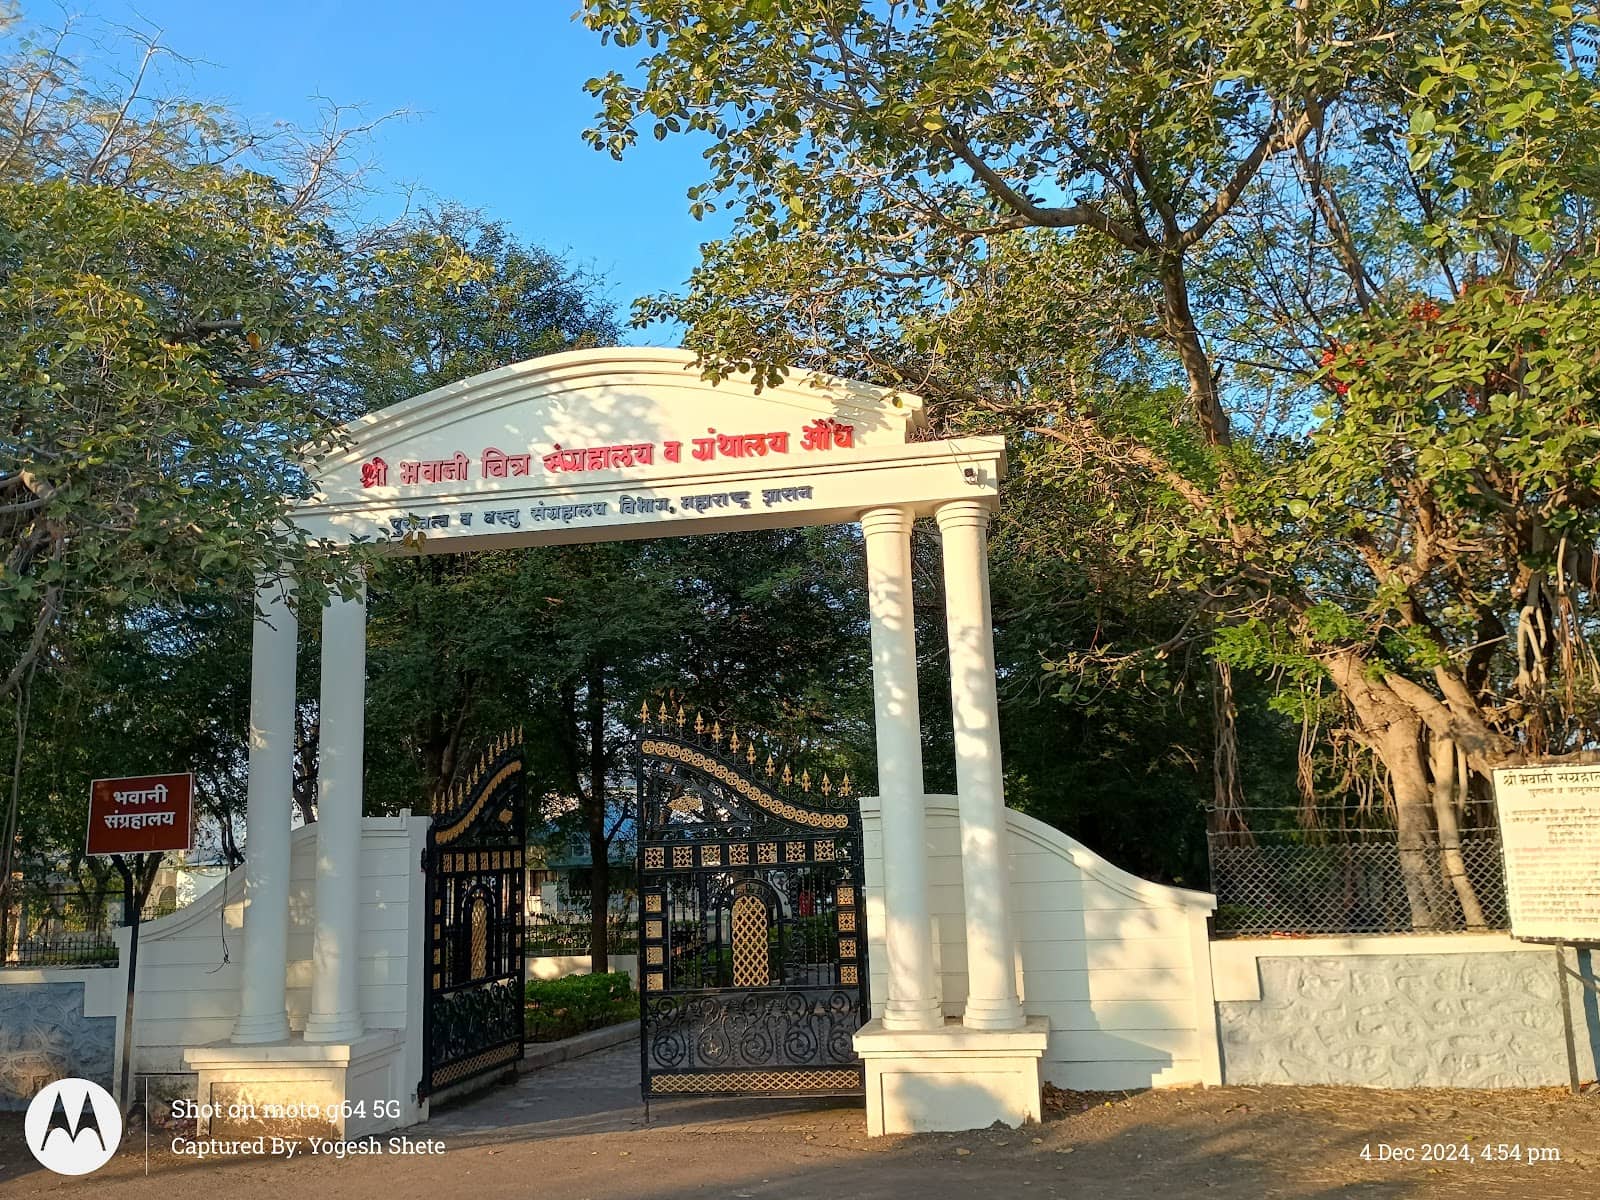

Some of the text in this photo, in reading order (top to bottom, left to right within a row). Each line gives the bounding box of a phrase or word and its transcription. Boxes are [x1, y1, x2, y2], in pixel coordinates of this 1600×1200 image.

[360, 418, 854, 488] श्री भवानी चित्र संग्रहालय व ग्रंथालय औंध
[390, 485, 814, 538] पुरतत्व व वस्तु संग्रहालय विभाग, महाराष्ट्र शासन
[113, 784, 168, 805] भवानी
[103, 809, 176, 830] संग्रहालय
